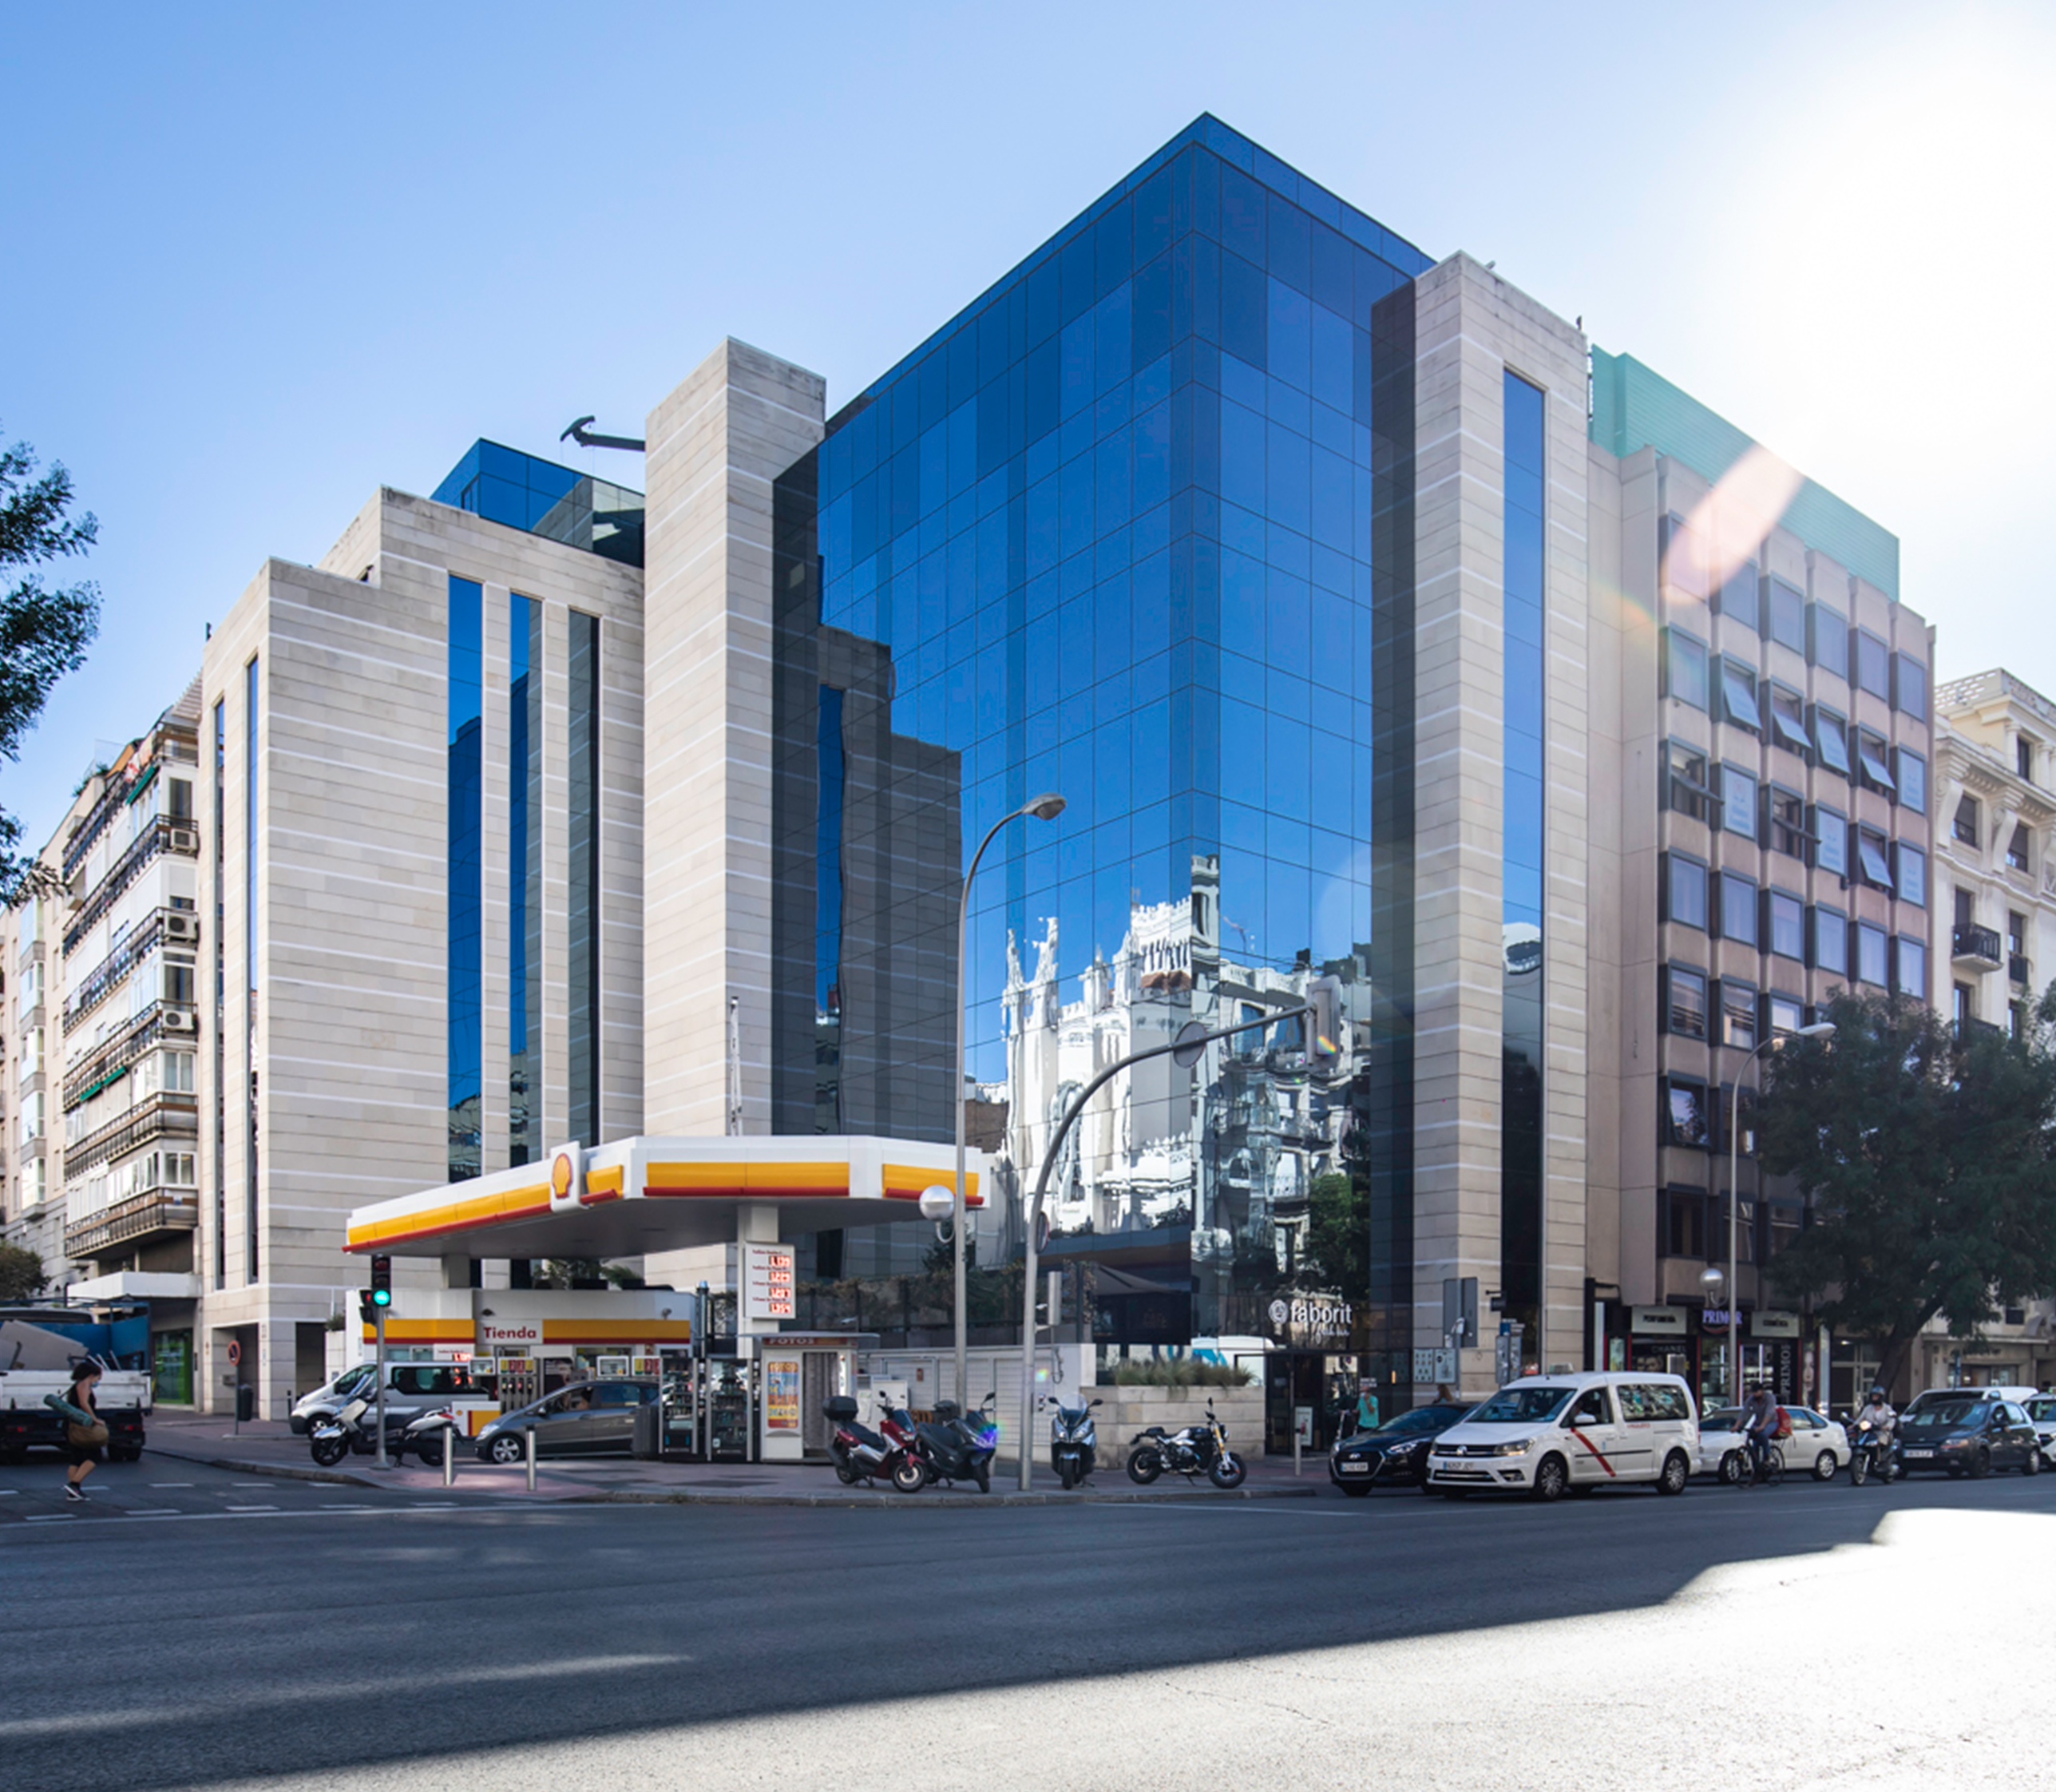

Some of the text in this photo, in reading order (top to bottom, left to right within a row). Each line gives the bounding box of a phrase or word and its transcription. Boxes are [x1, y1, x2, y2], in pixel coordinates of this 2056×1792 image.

[1290, 1302, 1352, 1323] faborit
[1702, 1310, 1742, 1324] PRIMR
[483, 1326, 537, 1339] Tienda
